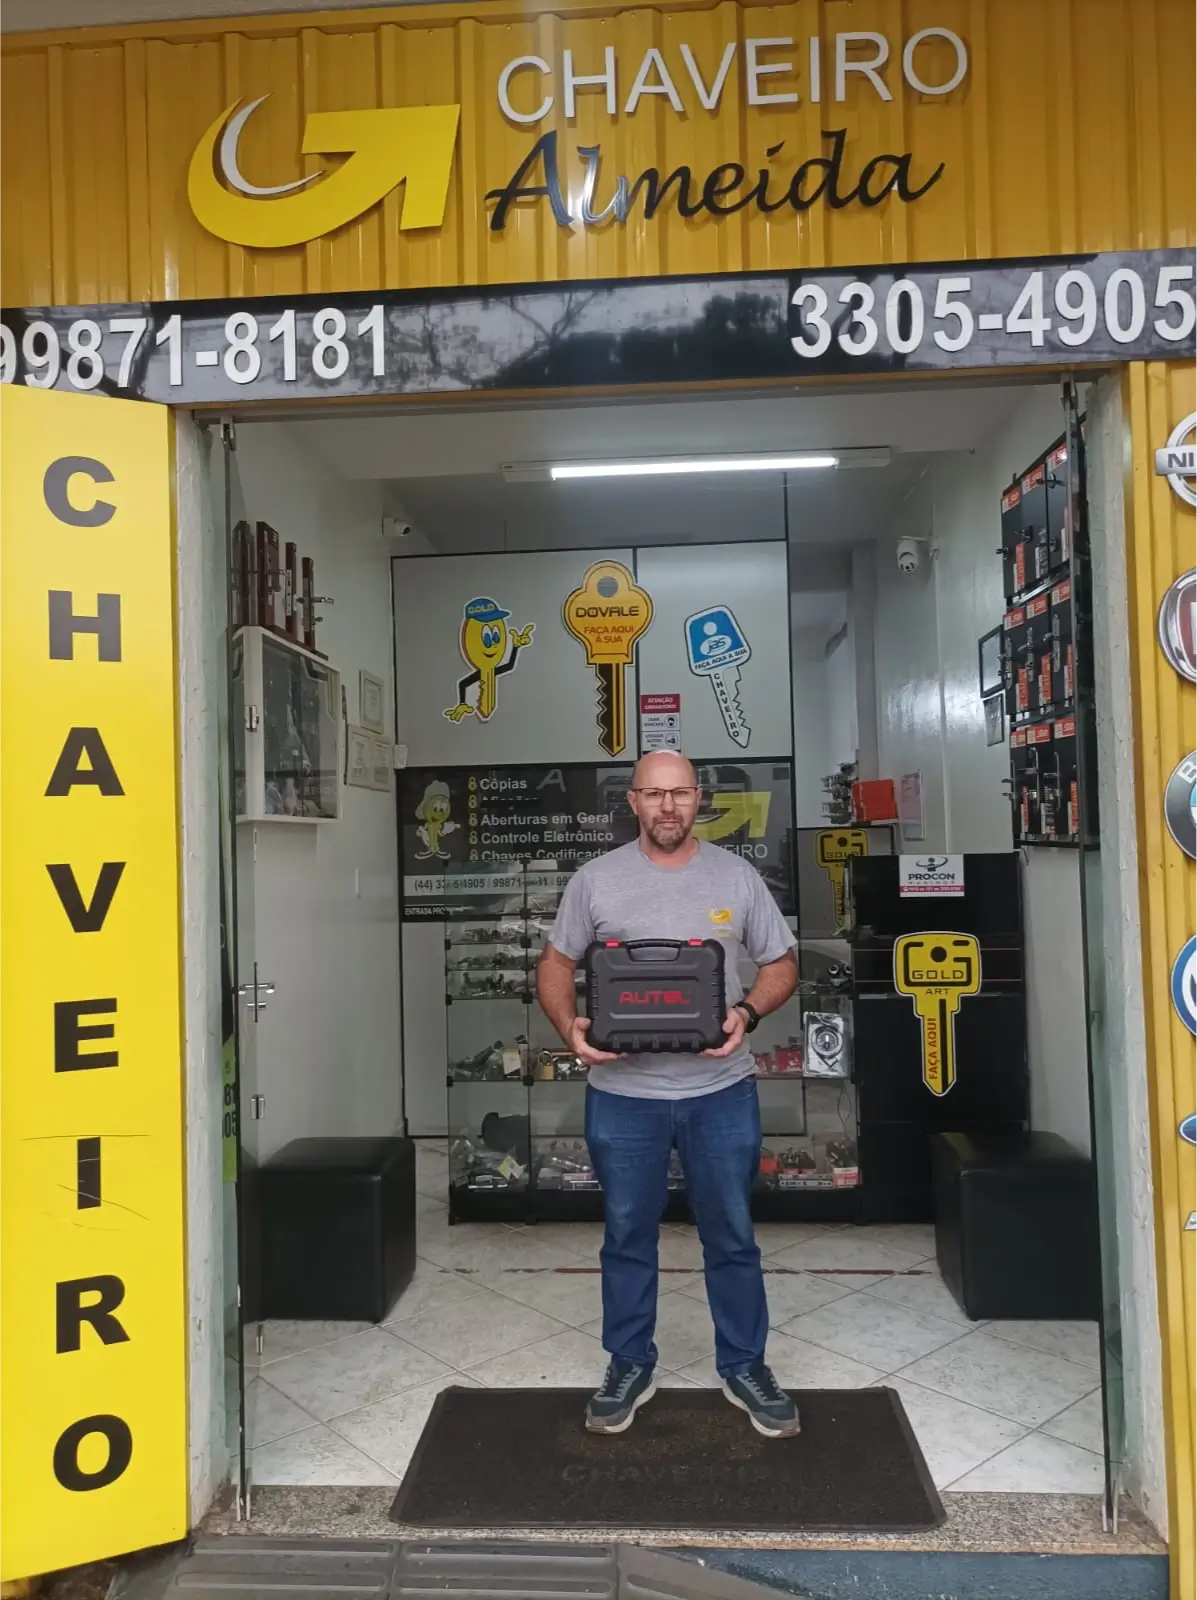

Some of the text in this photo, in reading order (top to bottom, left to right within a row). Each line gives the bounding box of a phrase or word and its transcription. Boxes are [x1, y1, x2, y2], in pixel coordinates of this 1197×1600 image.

[497, 27, 968, 123] CHAVEIRO
[484, 128, 945, 231] Almeida
[790, 265, 1196, 358] 3305-4905
[575, 605, 640, 618] DOVALE
[611, 624, 634, 633] AQUI
[713, 673, 740, 737] CHAVEIRO
[480, 777, 527, 792] Cópias
[480, 812, 613, 827] Aberturas em Geral
[481, 830, 614, 844] Controle Eletrônico
[43, 456, 134, 1492] CHAVEIRO
[912, 969, 964, 980] GOLD
[619, 990, 690, 1004] AUTEL
[925, 988, 951, 996] ART
[927, 1018, 939, 1080] FAÇA AQUI
